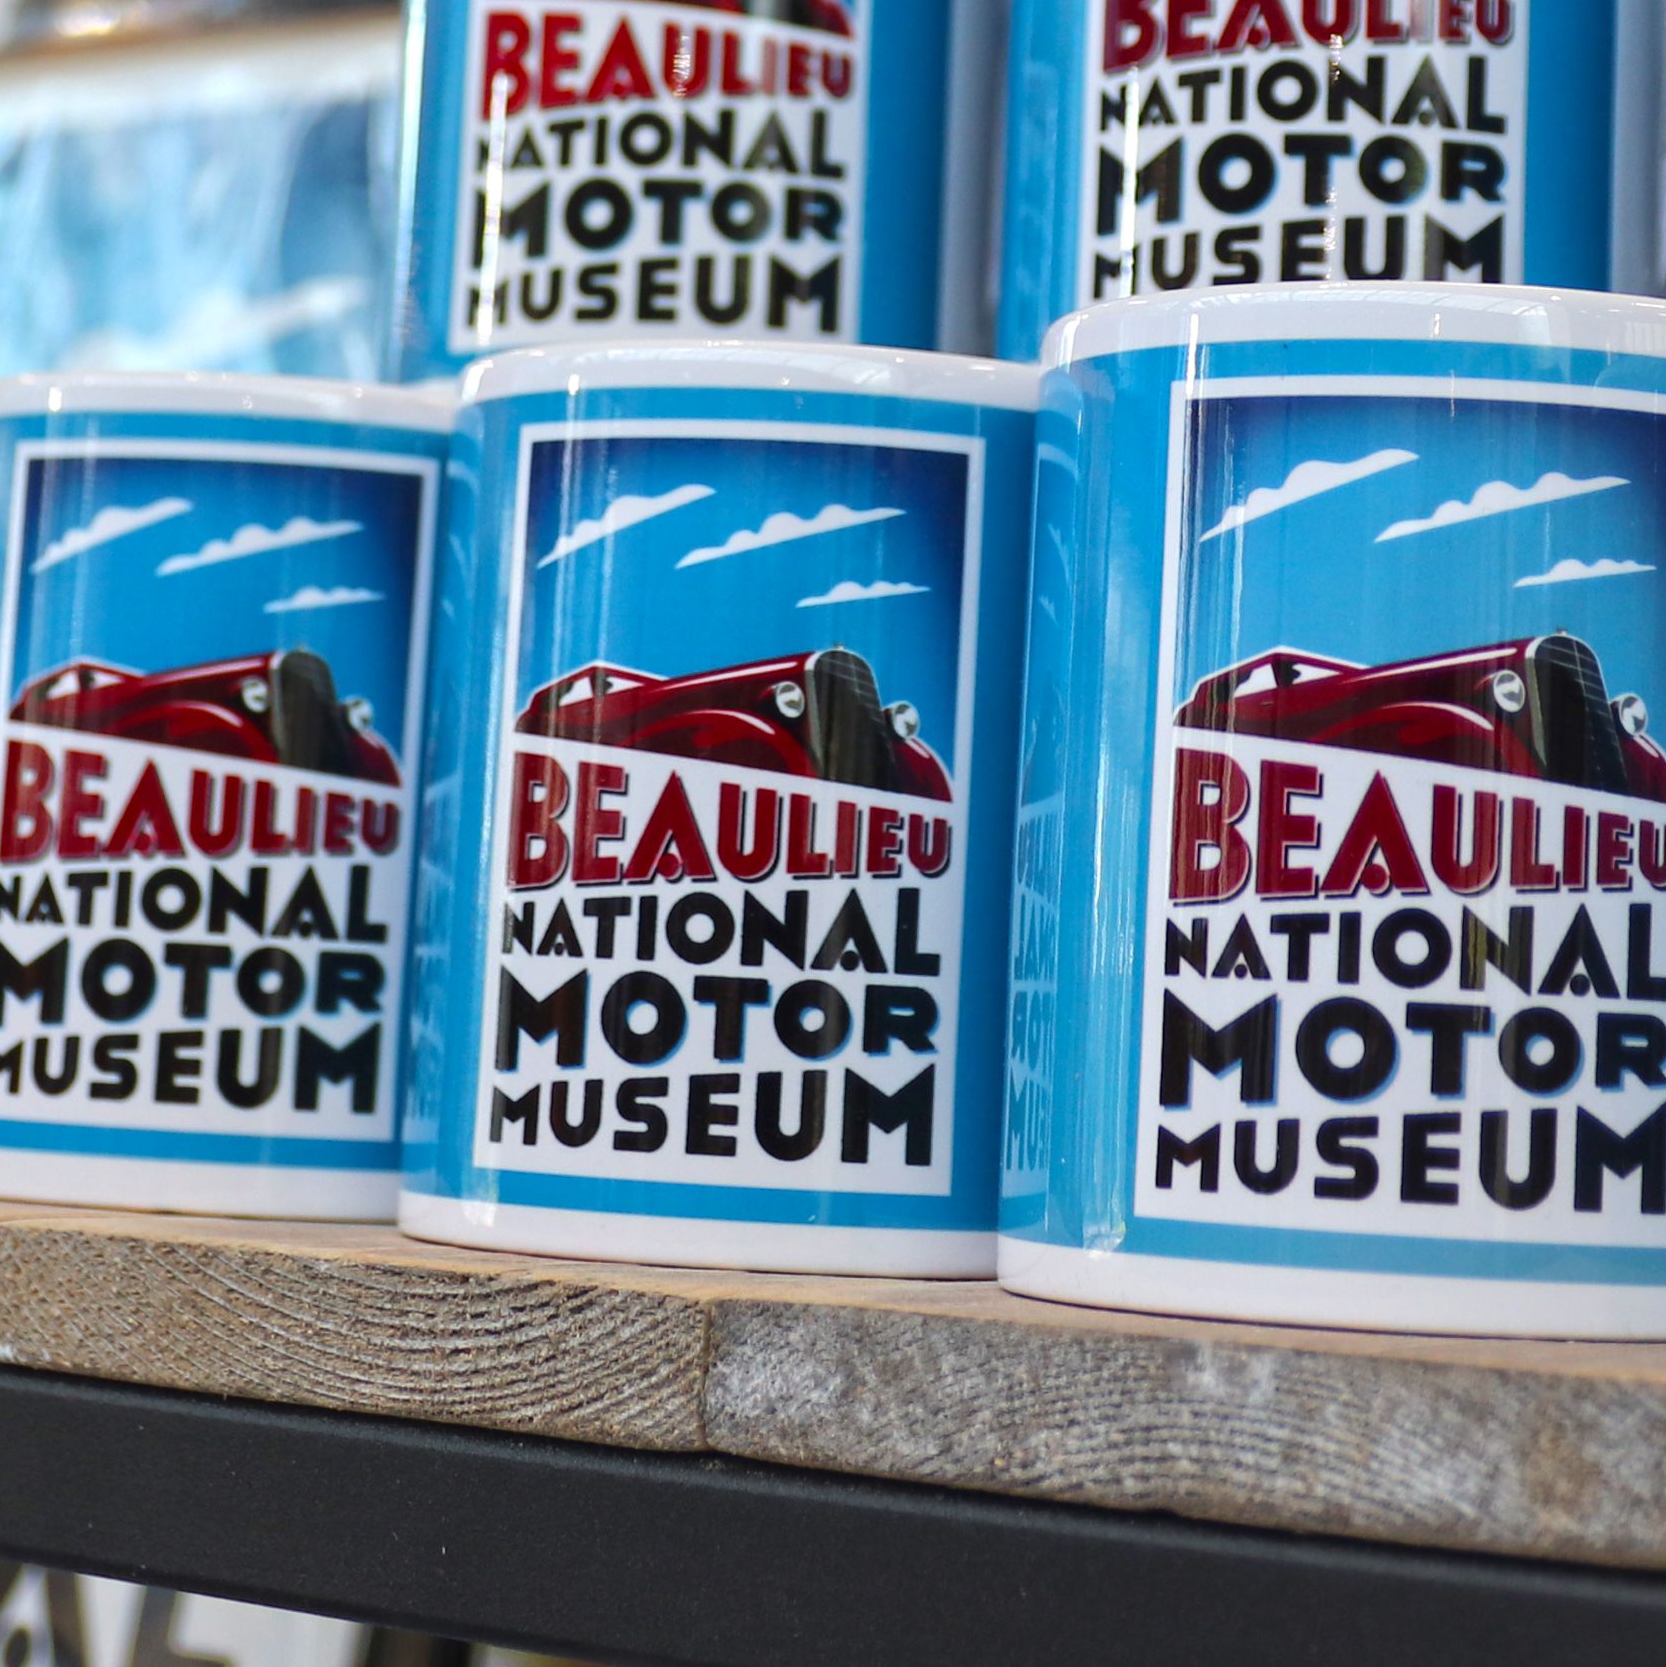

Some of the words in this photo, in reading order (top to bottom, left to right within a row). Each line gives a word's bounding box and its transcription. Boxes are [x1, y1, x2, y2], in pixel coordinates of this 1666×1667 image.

[482, 10, 853, 121] BEAULIEU
[1100, 55, 1507, 135] NATIONAL
[476, 107, 845, 180] NATIONAL
[1097, 133, 1507, 237] MOTOR
[472, 177, 844, 270] MOTOR
[1093, 212, 1505, 300] MUSEUM
[467, 254, 842, 333] MUSEUM
[507, 751, 951, 891] BEAULIEU
[502, 888, 941, 977] NATIONAL
[495, 964, 939, 1072] MOTOR
[489, 1063, 935, 1167] MUSEUM
